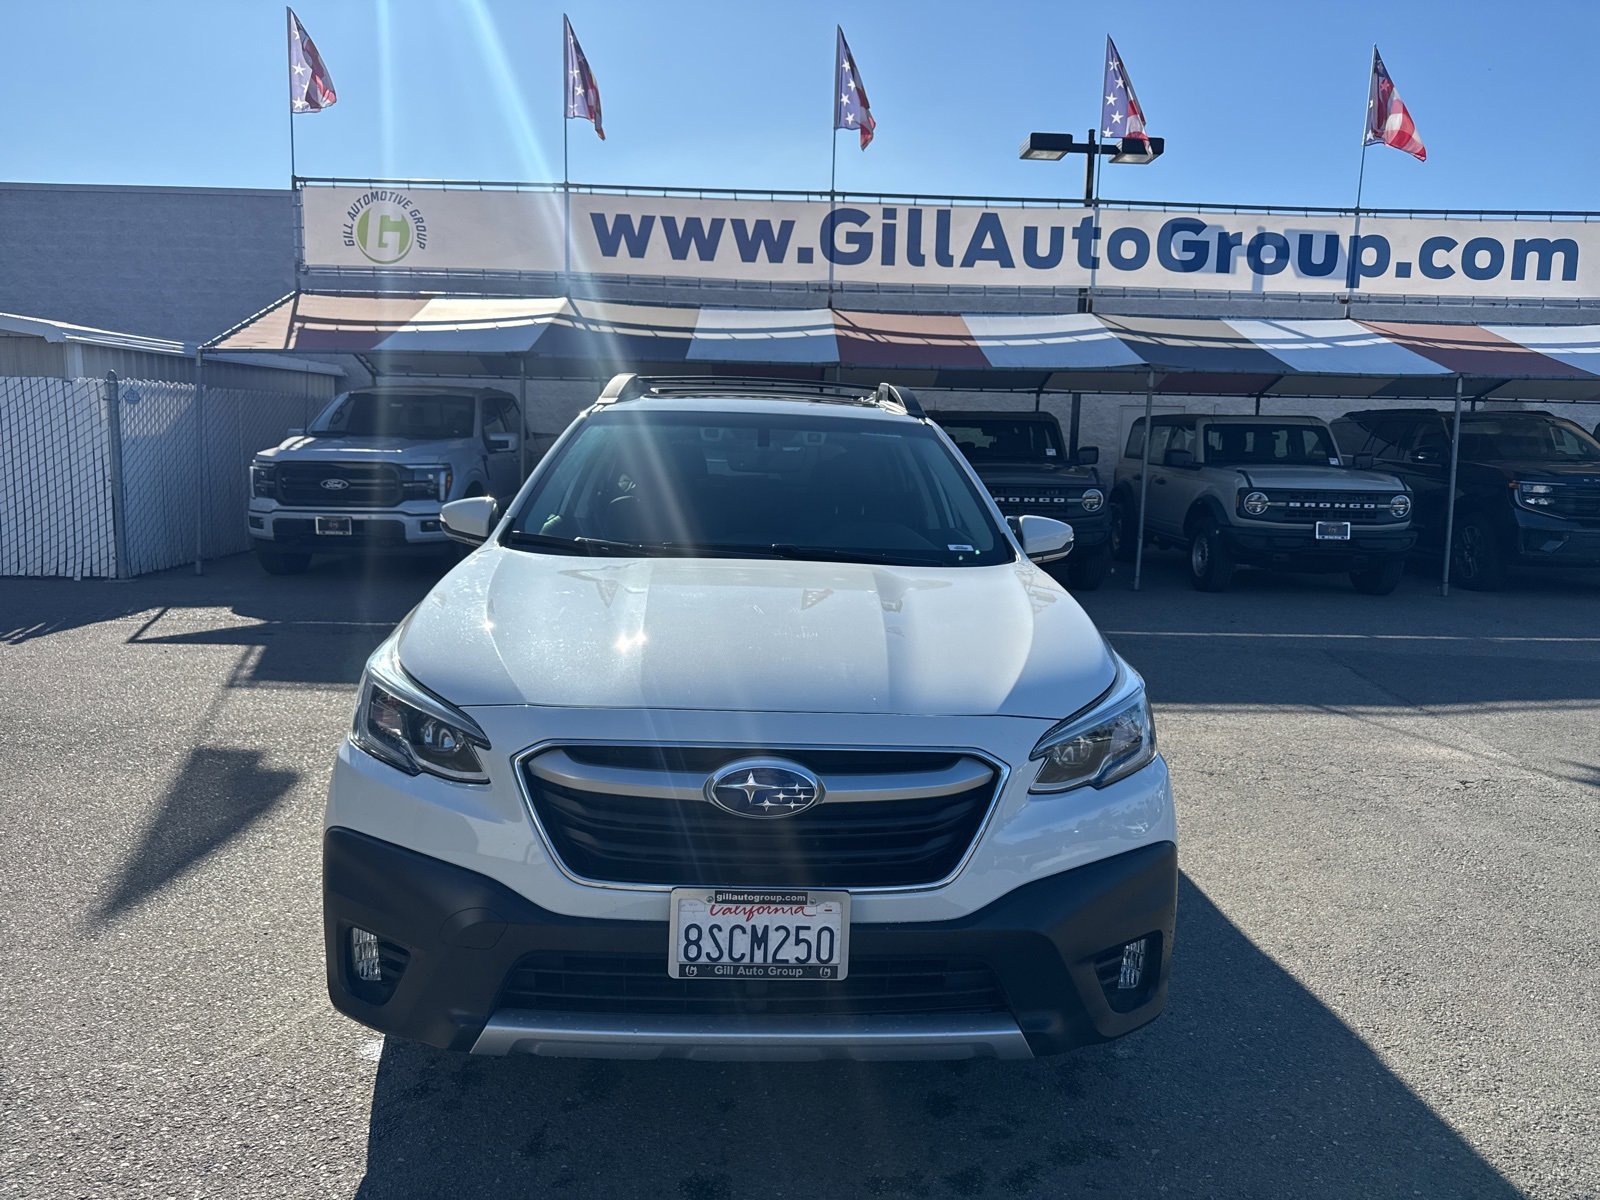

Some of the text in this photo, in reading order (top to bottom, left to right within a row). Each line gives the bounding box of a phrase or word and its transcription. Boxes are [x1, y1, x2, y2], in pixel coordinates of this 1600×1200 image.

[343, 191, 427, 250] GILL AUTOMOTIVE GROUP
[589, 207, 1579, 289] www.GillAutoGroup.com
[716, 893, 807, 903] gillautogroup.com
[709, 904, 816, 922] California
[683, 923, 835, 964] 8SCM250
[714, 965, 734, 975] Gill
[737, 966, 764, 976] Auto
[768, 966, 803, 977] Group
